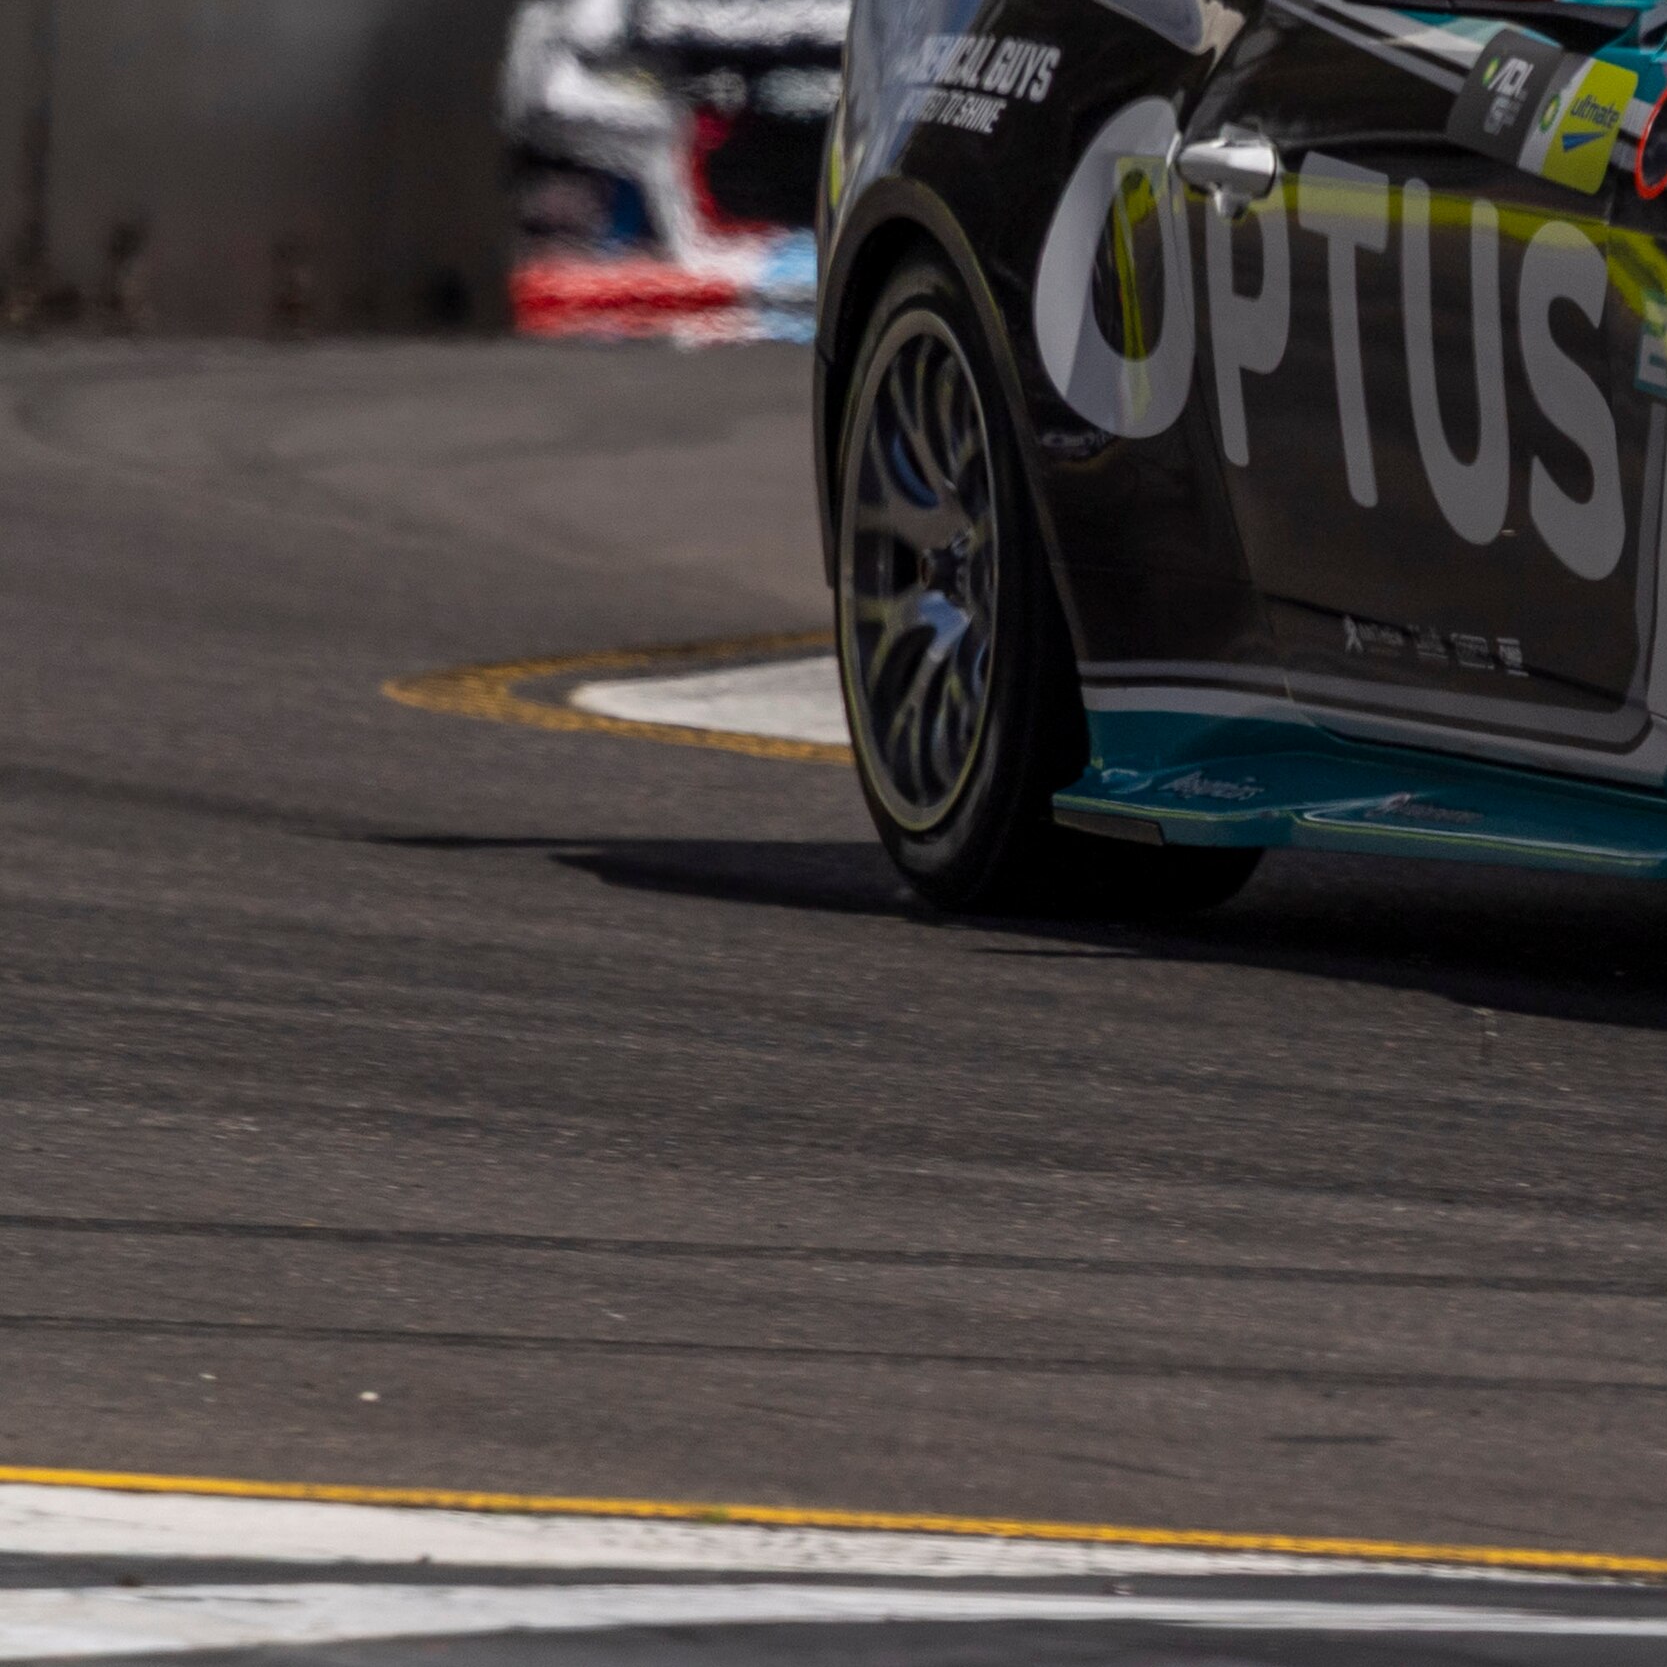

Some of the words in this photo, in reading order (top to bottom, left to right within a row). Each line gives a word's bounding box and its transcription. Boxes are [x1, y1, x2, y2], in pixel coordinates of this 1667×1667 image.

[982, 35, 1062, 103] GUYS
[1569, 93, 1621, 131] ultimate
[1031, 95, 1625, 582] OPTUS
